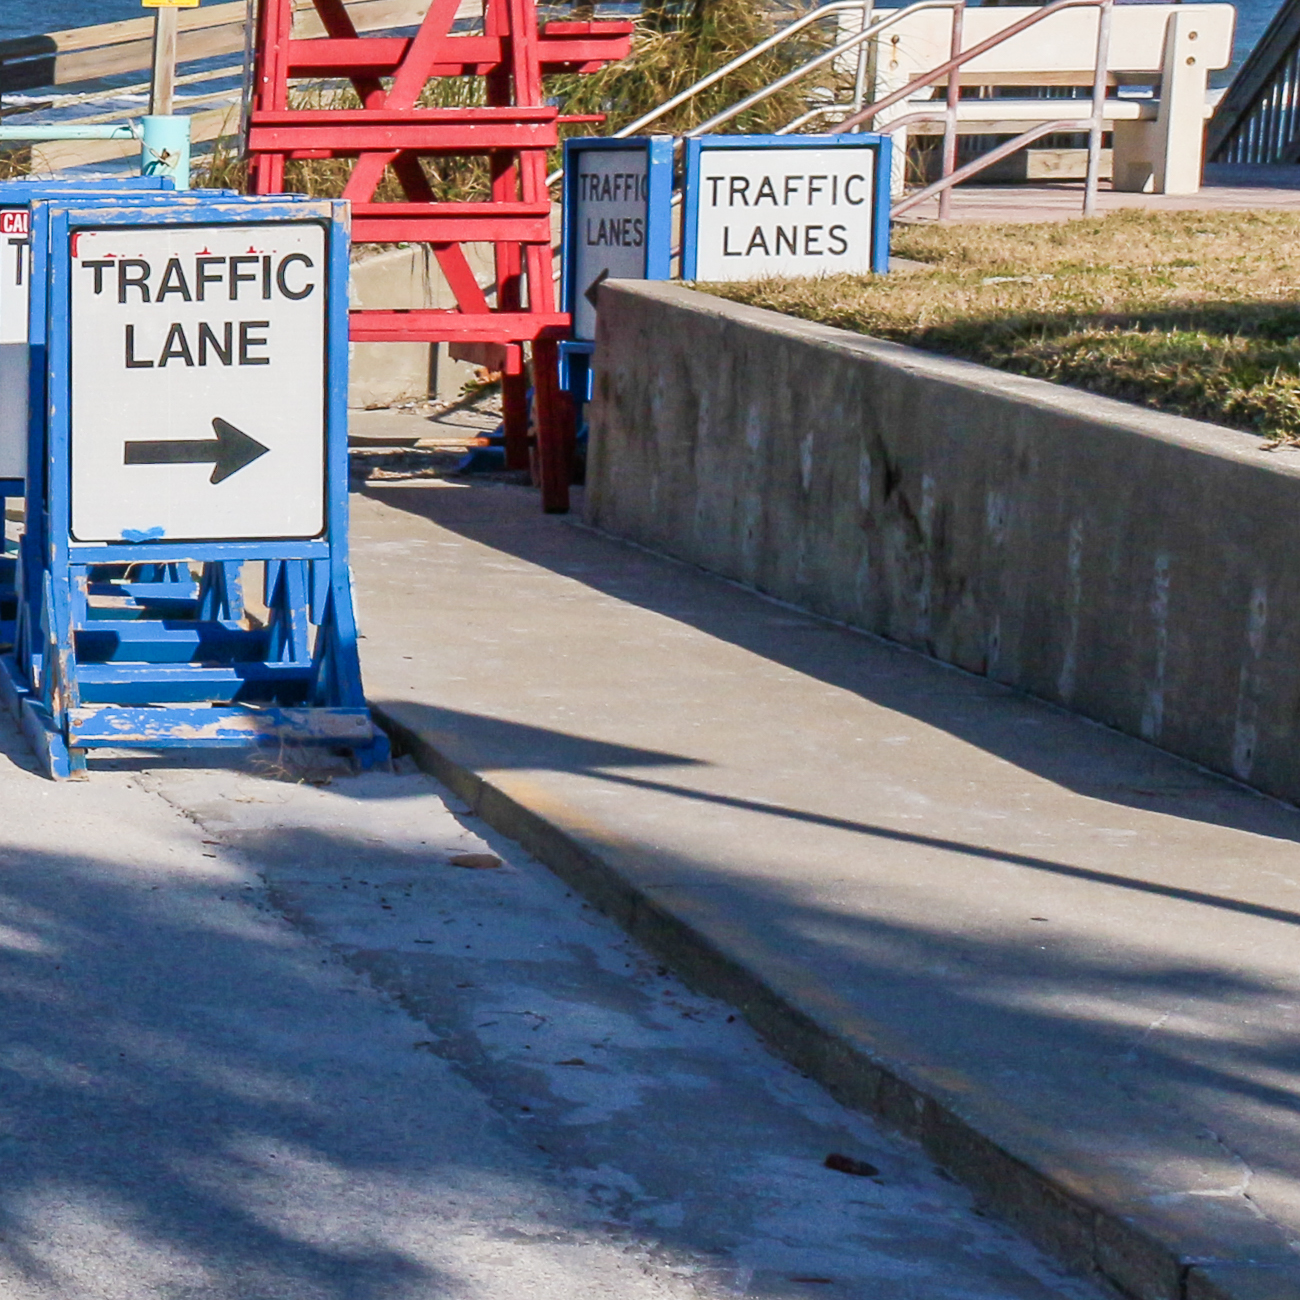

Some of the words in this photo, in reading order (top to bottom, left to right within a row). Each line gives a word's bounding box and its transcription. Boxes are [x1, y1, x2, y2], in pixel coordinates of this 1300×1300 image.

[580, 174, 648, 201] TRAFFIC
[706, 175, 865, 206] TRAFFIC
[587, 218, 644, 247] LANES
[723, 225, 847, 256] LANES
[82, 254, 314, 304] TRAFFIC
[125, 321, 270, 368] LANE
